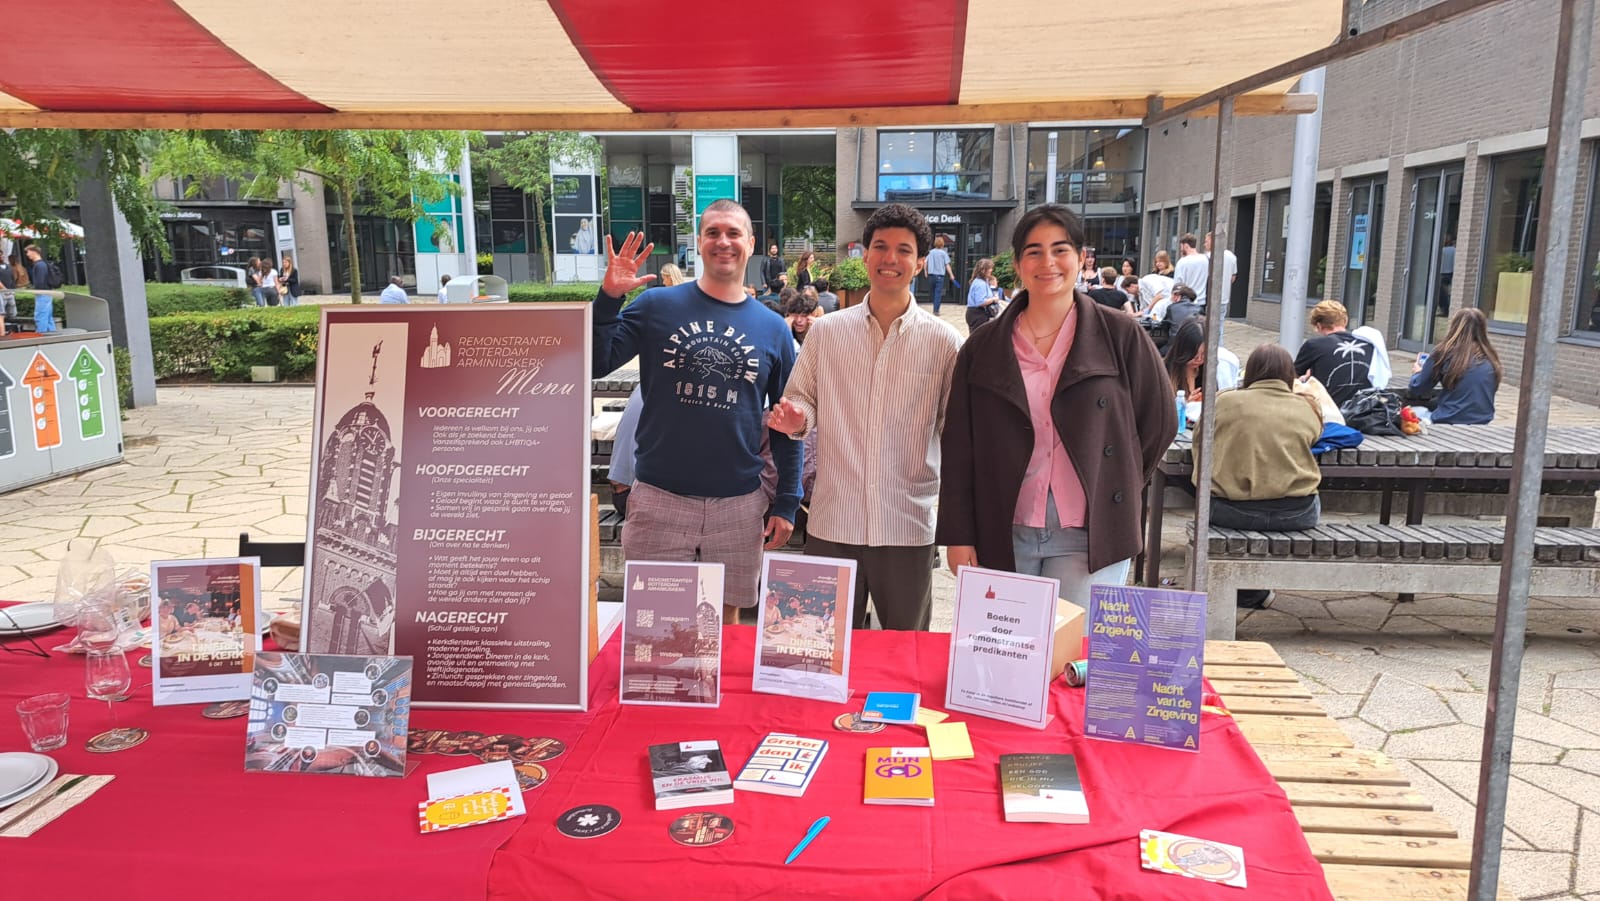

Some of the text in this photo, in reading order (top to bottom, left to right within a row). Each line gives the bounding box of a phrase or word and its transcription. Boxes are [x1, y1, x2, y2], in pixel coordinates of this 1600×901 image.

[941, 213, 962, 223] Desk
[458, 336, 562, 346] REMONSTRANTEN
[457, 347, 530, 357] ROTTERDAM
[663, 320, 760, 384] ALPINE BLAUW
[685, 336, 730, 350] MOUNTAIN
[730, 346, 744, 379] EDITION
[456, 358, 545, 368] ARMINIUSKERK
[496, 366, 576, 396] Menu
[726, 389, 738, 404] M
[418, 406, 521, 419] VOORGERECHT
[500, 425, 510, 433] bij
[524, 425, 533, 433] jij
[416, 464, 530, 476] HOOFDGERECHT
[432, 476, 494, 485] (Onze specialiteit)
[457, 491, 487, 499] invulling
[503, 491, 538, 500] zingeving
[459, 498, 483, 506] begint
[562, 506, 571, 515] jij
[413, 529, 506, 541] BIJGERECHT
[429, 541, 445, 549] (Om
[481, 542, 510, 550] denken)
[449, 555, 468, 563] geeft
[481, 556, 500, 564] jouw
[437, 576, 453, 584] mag
[476, 576, 498, 584] kijken
[531, 577, 551, 585] schip
[519, 597, 531, 605] jij?
[1099, 600, 1130, 612] Nacht
[415, 611, 509, 624] NAGERECHT
[986, 611, 1021, 624] Boeken
[1103, 614, 1138, 625] van de
[427, 624, 453, 632] (Schuif
[452, 625, 481, 633] gezellig
[991, 625, 1013, 635] door
[1093, 622, 1144, 641] Zingeving
[480, 639, 513, 647] klassieke
[968, 633, 1035, 650] remonstrantse
[177, 650, 245, 662] IN DE KERK
[776, 645, 789, 654] IN
[790, 647, 804, 656] DE
[804, 648, 834, 660] KERK
[973, 645, 1028, 661] predikanten
[477, 660, 520, 668] ontmoeting
[523, 674, 558, 682] zingeving
[437, 680, 487, 688] maatschappij
[1152, 682, 1185, 696] Nacht
[1156, 697, 1193, 709] van de
[1146, 705, 1198, 725] Zingeving
[766, 737, 820, 749] Groter
[759, 748, 792, 757] dan
[788, 761, 806, 771] ik
[875, 763, 922, 778] GOD
